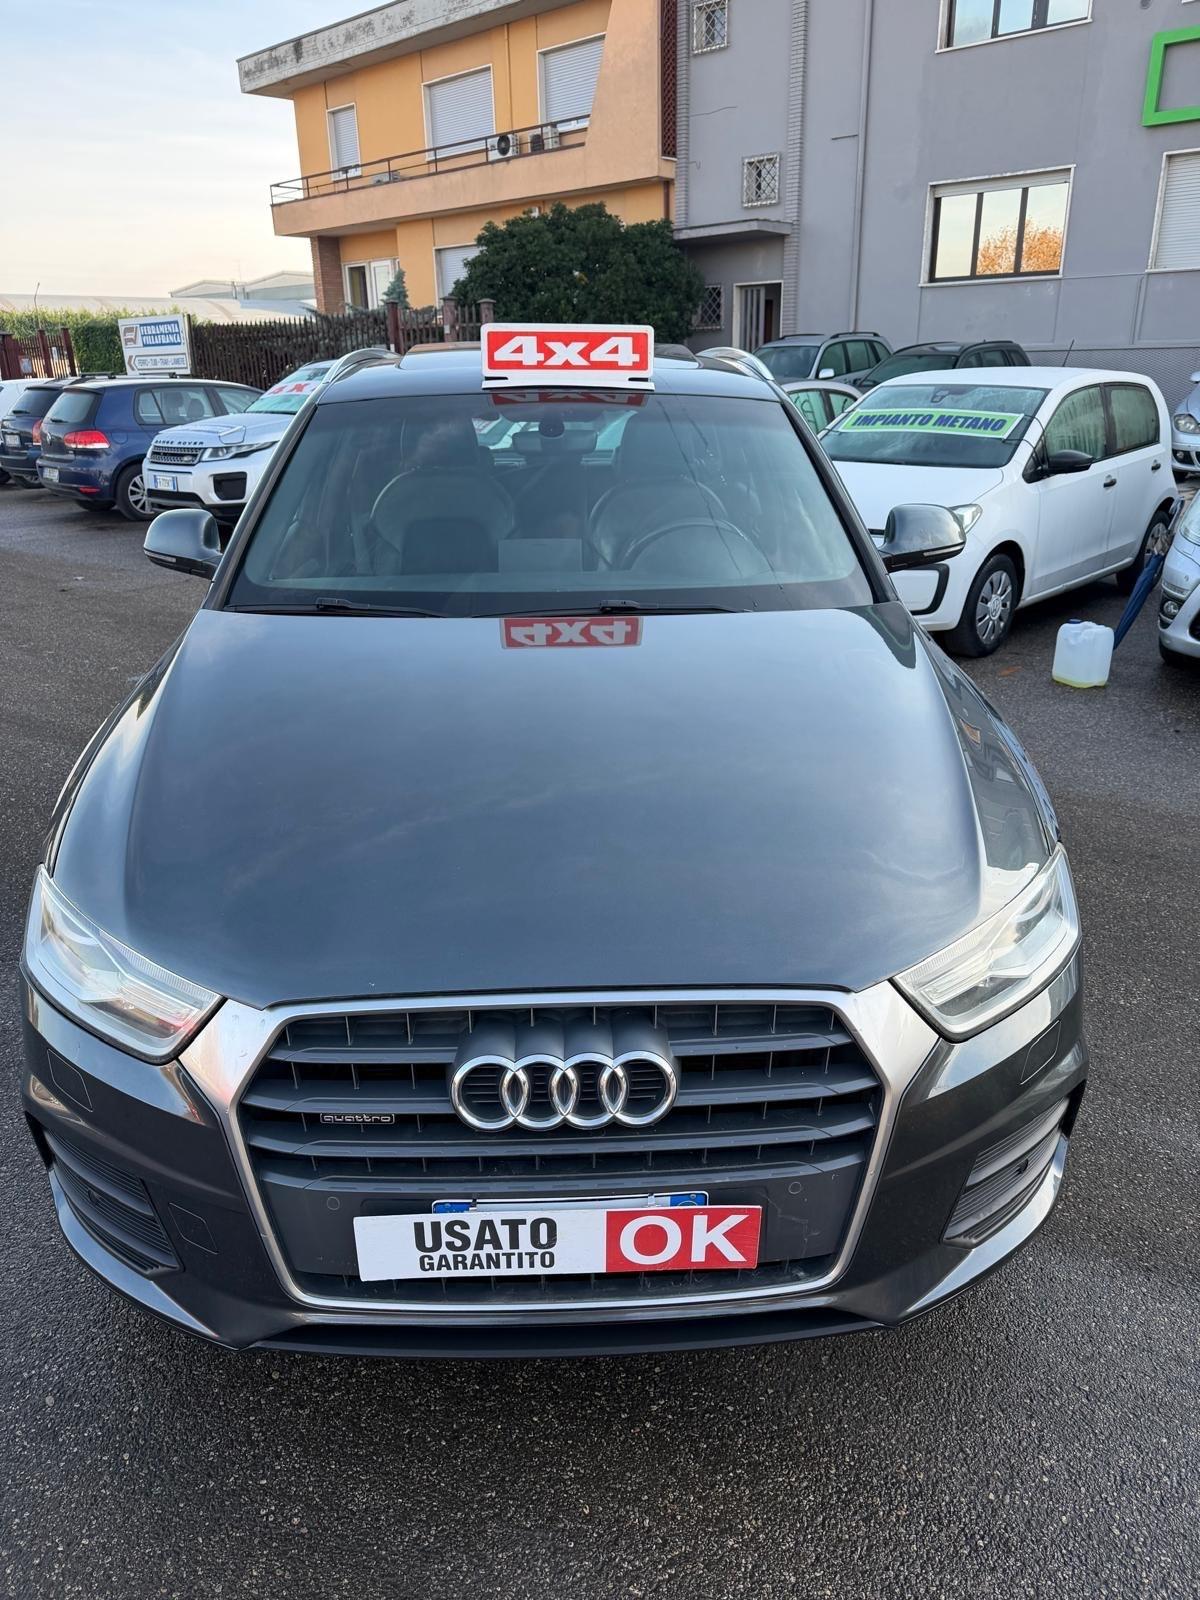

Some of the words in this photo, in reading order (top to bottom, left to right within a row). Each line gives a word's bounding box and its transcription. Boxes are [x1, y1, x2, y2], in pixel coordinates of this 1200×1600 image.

[494, 336, 640, 366] 4x4
[851, 414, 934, 426] IMPIANTO
[932, 415, 1008, 431] METANO
[323, 1113, 391, 1123] quattro
[413, 1217, 557, 1253] USATO
[619, 1214, 749, 1265] OK
[419, 1250, 555, 1272] GARANTITO
